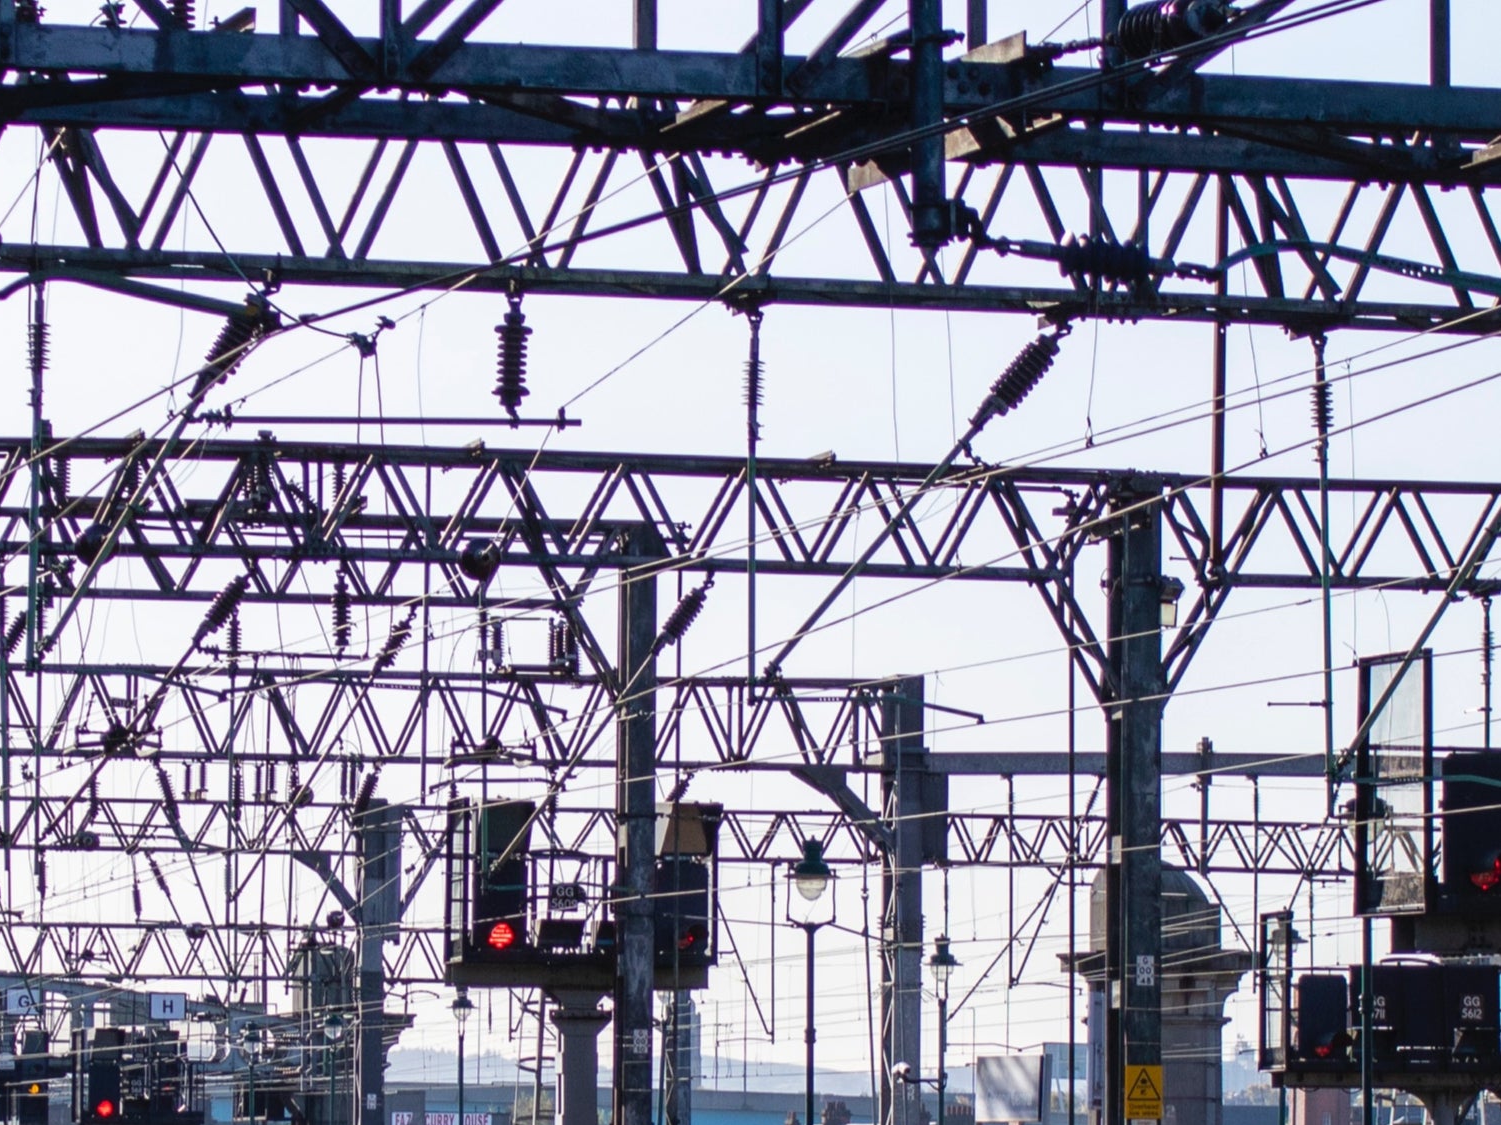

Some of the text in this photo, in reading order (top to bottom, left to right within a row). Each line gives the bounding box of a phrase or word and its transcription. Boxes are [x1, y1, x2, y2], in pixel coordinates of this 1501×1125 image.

[556, 886, 574, 897] GG
[18, 995, 30, 1008] G
[162, 999, 174, 1014] H
[1372, 995, 1386, 1007] G
[1463, 995, 1481, 1007] GG
[1371, 1008, 1386, 1020] 711
[1461, 1007, 1484, 1020] 5612
